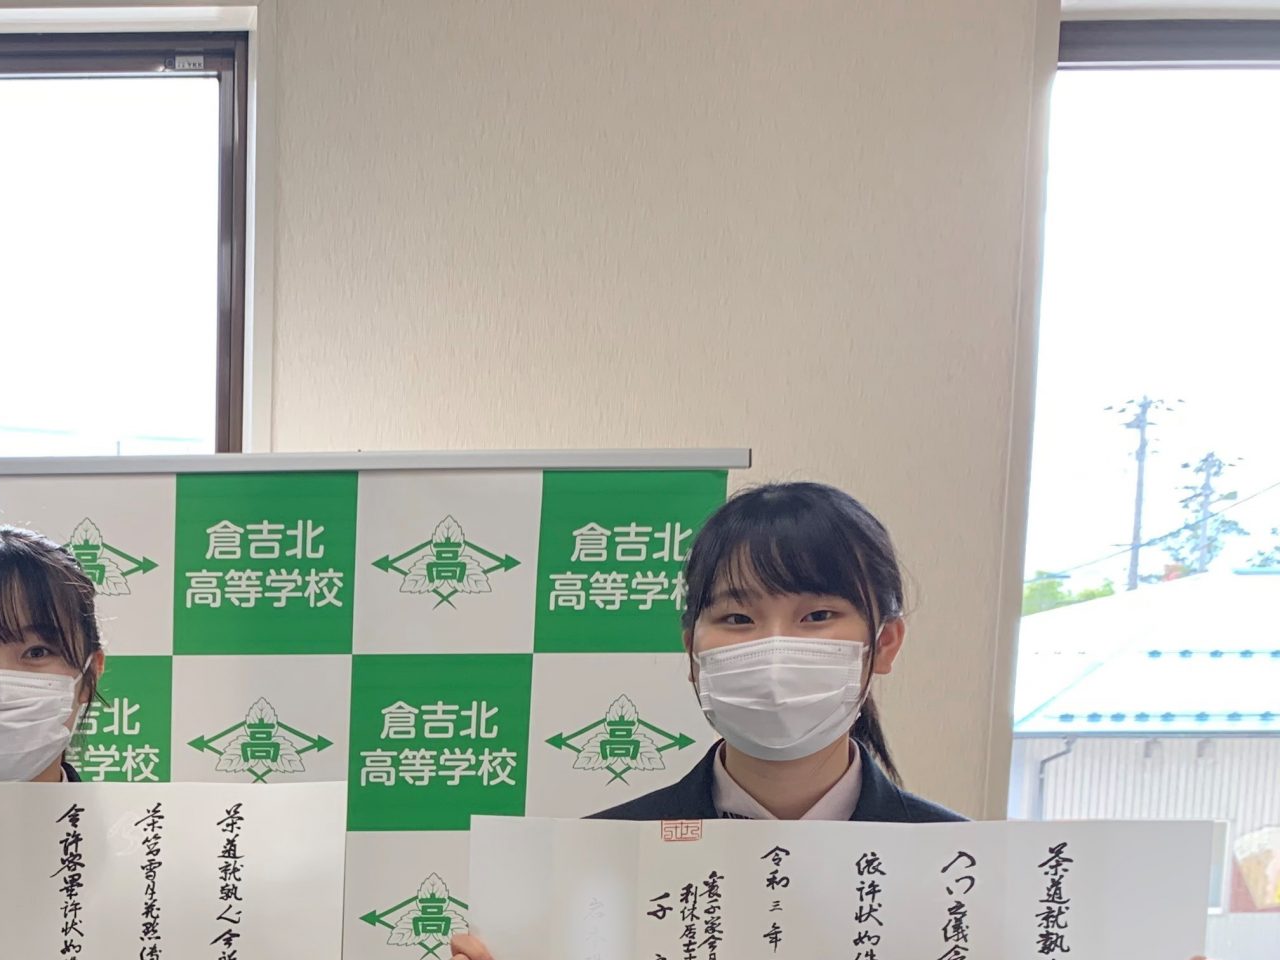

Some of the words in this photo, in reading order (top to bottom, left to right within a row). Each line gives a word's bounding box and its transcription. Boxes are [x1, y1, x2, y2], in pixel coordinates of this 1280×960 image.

[205, 518, 326, 561] 倉吉北
[570, 521, 692, 563] 倉吉北
[184, 568, 344, 610] 高等学校
[379, 699, 499, 740] 倉吉北
[67, 743, 160, 782] 学校
[359, 746, 517, 787] 高等学校
